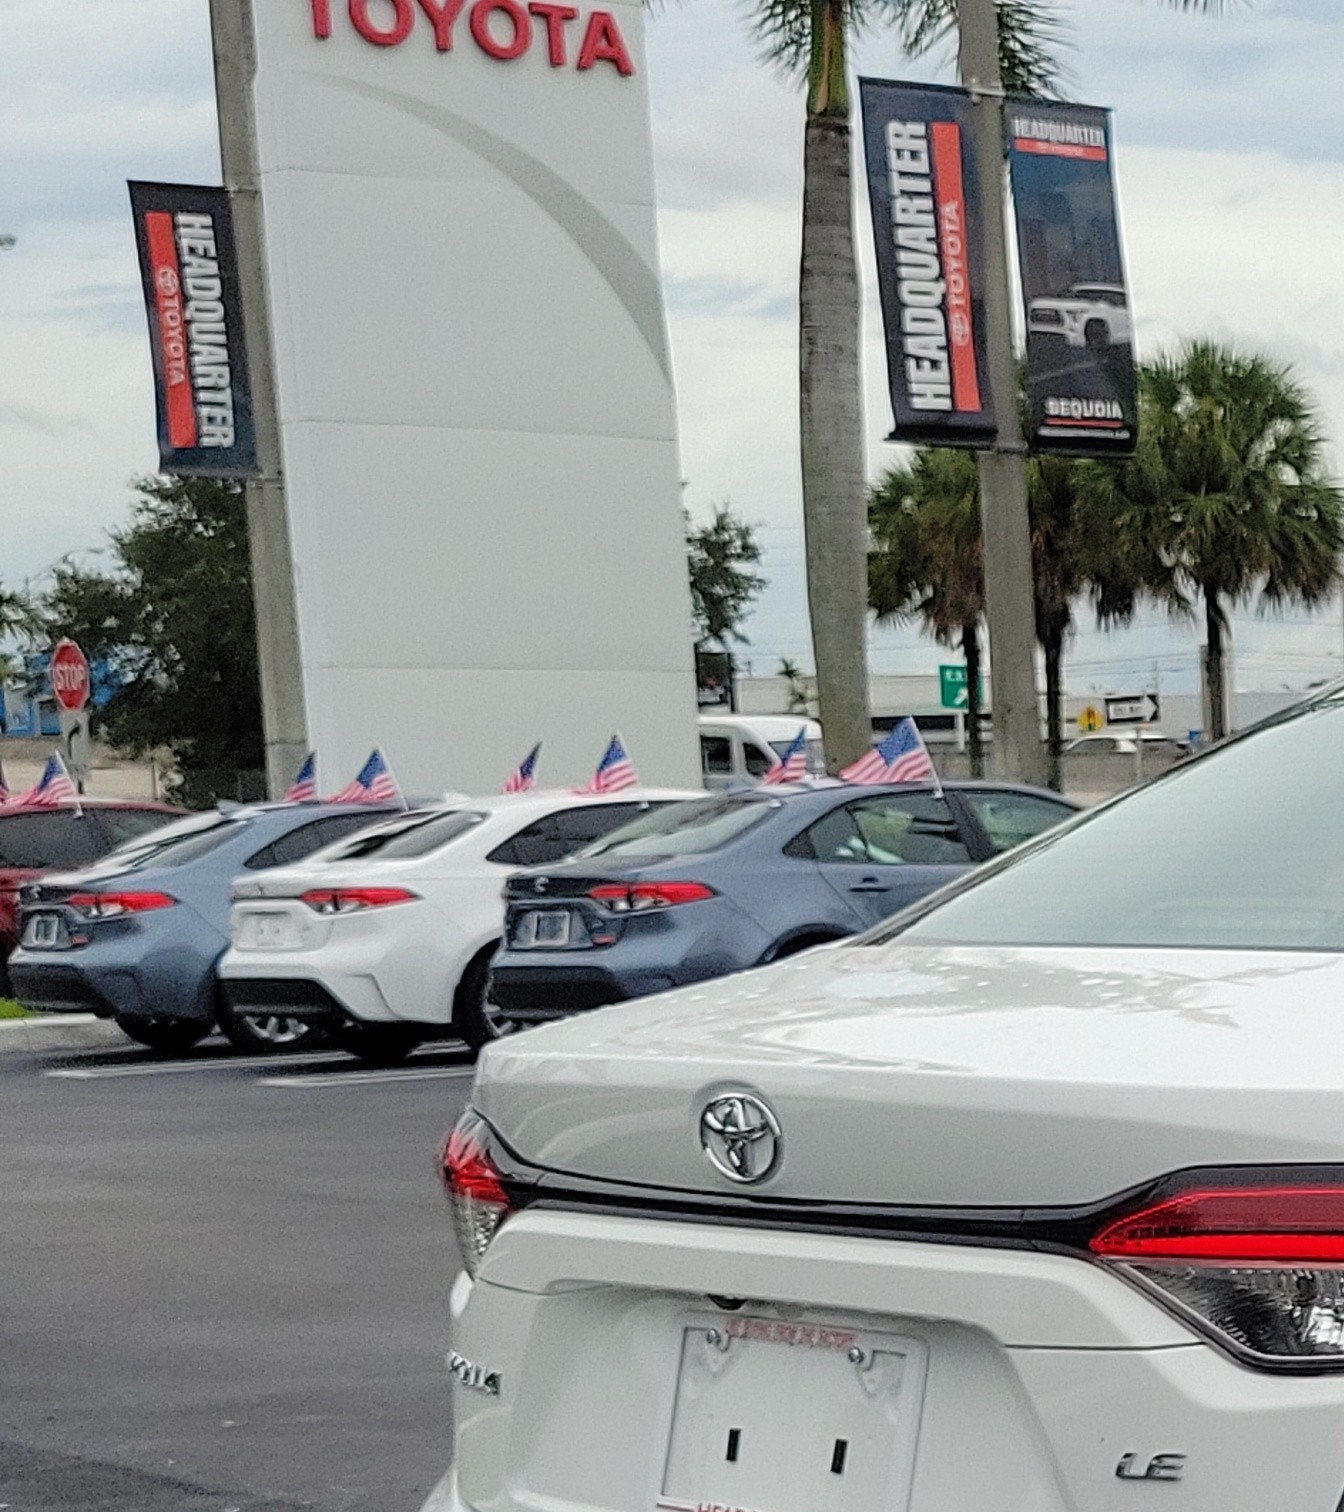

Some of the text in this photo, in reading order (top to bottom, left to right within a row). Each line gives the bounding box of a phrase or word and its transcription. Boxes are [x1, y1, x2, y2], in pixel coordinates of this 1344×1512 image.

[884, 119, 951, 412] HEADQUARTER
[938, 201, 971, 305] TOYOTA
[163, 295, 186, 387] TOYOTA
[173, 211, 235, 448] HEADQUARTER
[1044, 397, 1124, 420] SEQUOIA
[53, 663, 86, 691] STOP
[1115, 1453, 1188, 1481] LE
